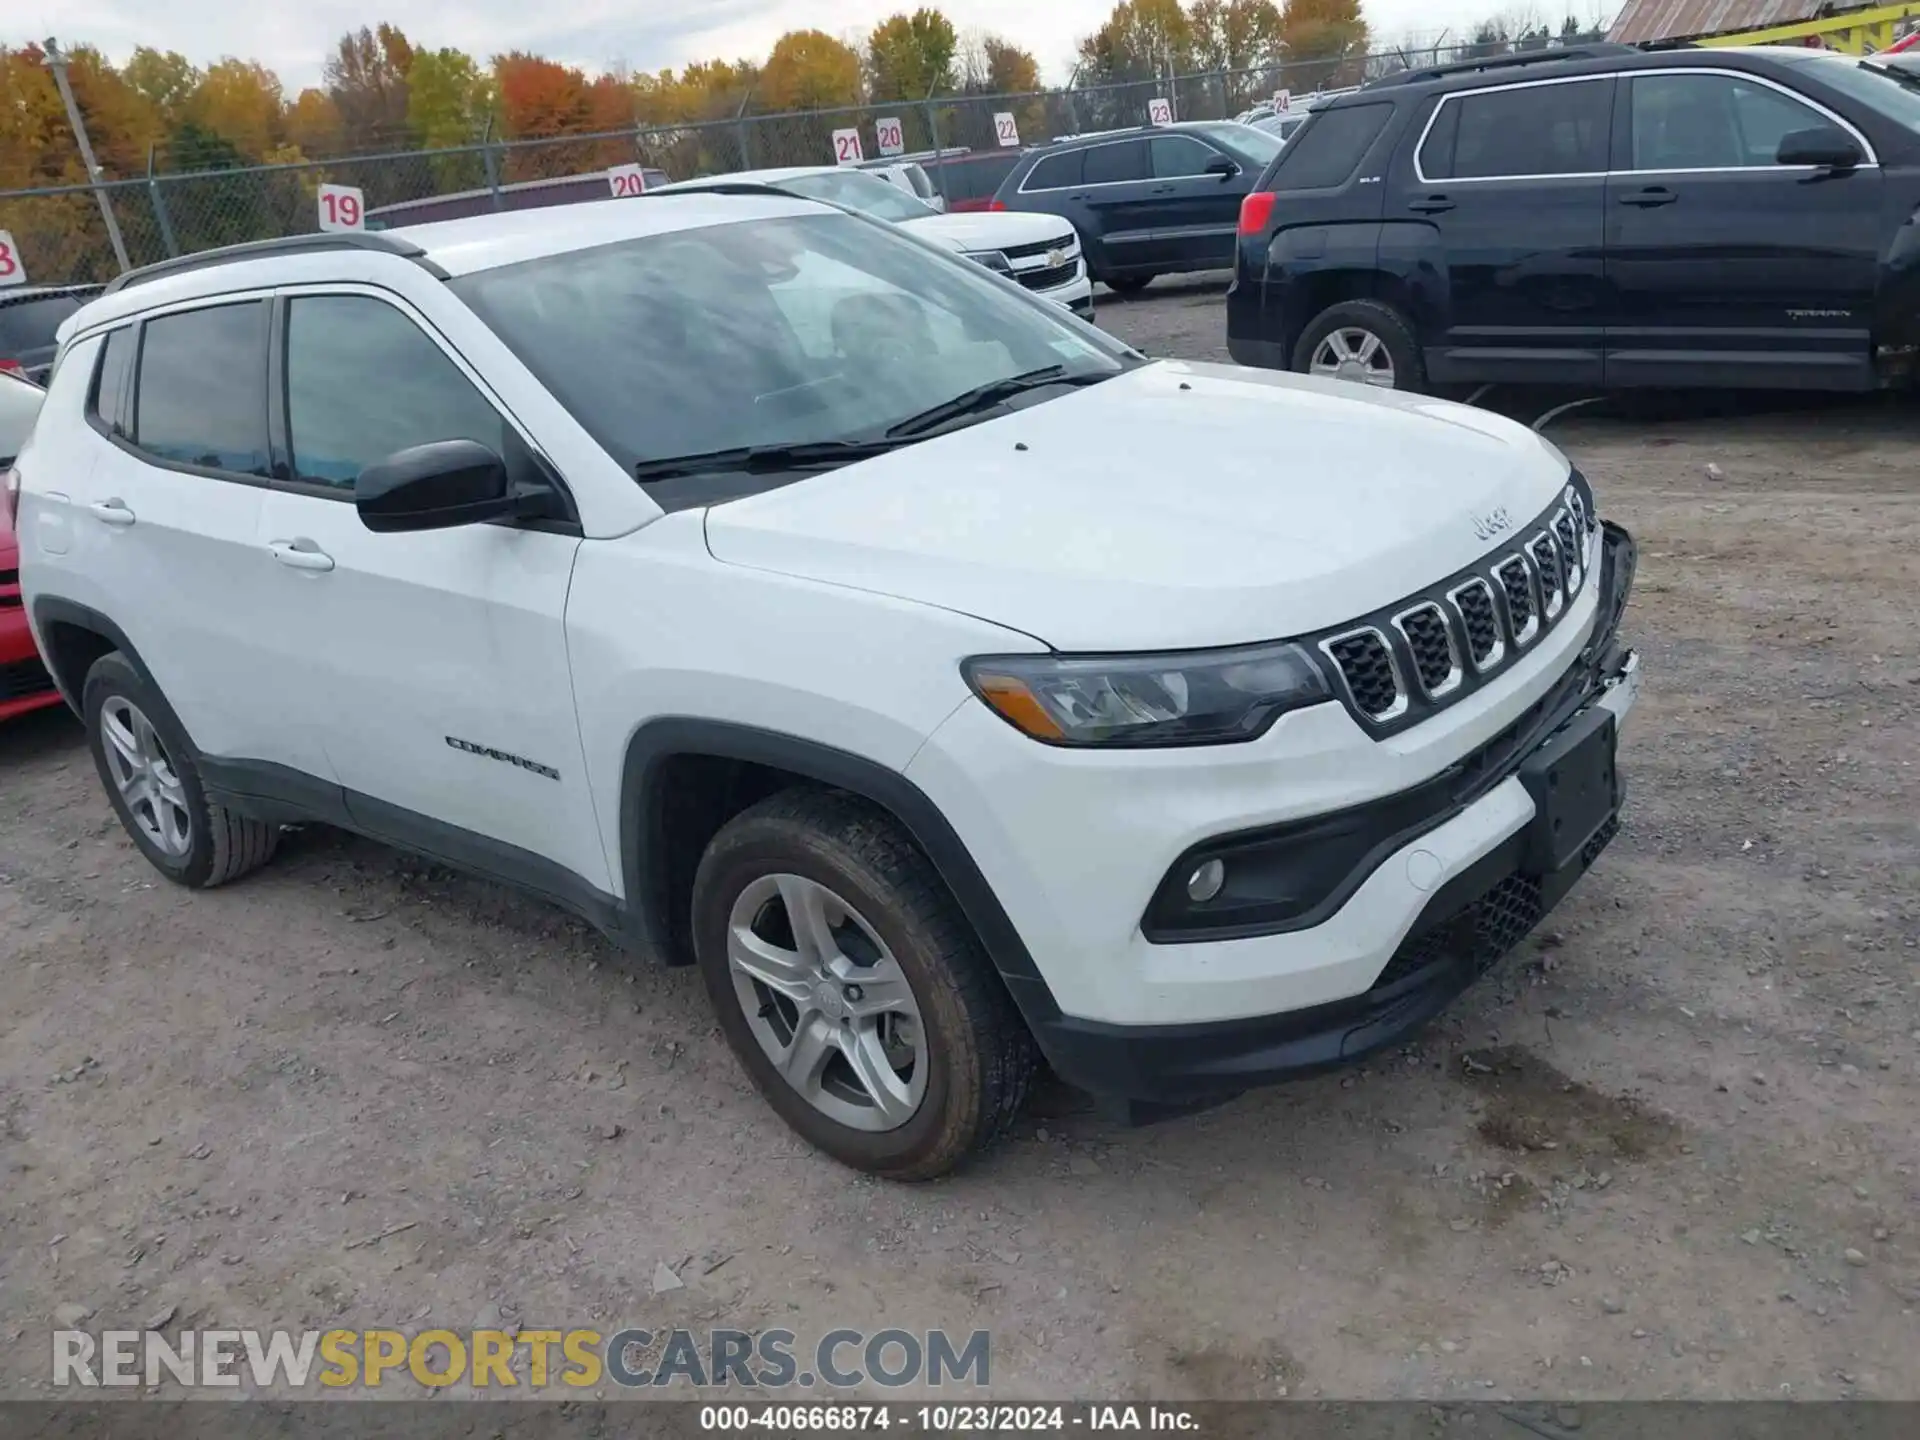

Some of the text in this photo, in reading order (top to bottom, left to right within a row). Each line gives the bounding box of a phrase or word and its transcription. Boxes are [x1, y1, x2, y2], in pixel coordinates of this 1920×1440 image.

[1152, 105, 1169, 122] 23
[880, 126, 900, 148] 20
[998, 120, 1016, 139] 22
[837, 136, 860, 160] 21
[613, 173, 642, 196] 20
[322, 193, 359, 226] 19
[445, 735, 560, 781] COMPASS
